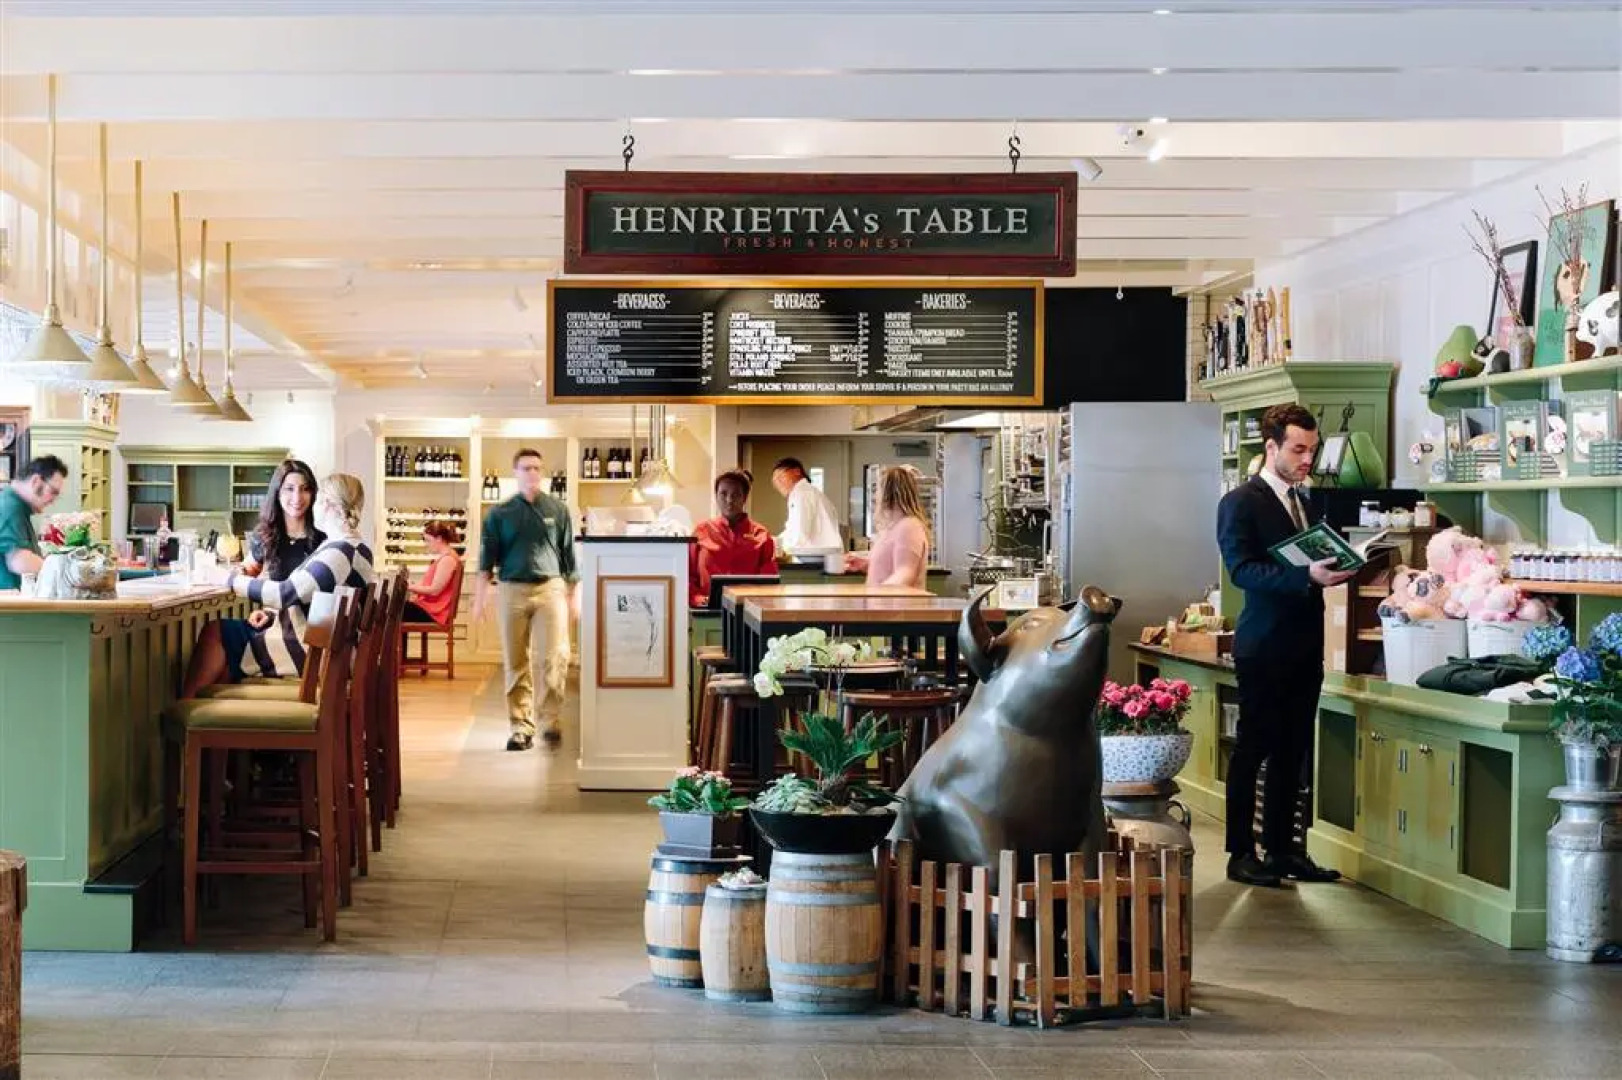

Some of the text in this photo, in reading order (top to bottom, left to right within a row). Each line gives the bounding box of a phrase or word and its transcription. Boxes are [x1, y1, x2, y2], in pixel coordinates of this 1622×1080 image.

[612, 207, 1028, 234] HENRIETTA's TABLE
[724, 237, 792, 248] FRESH
[828, 237, 914, 248] HONEST
